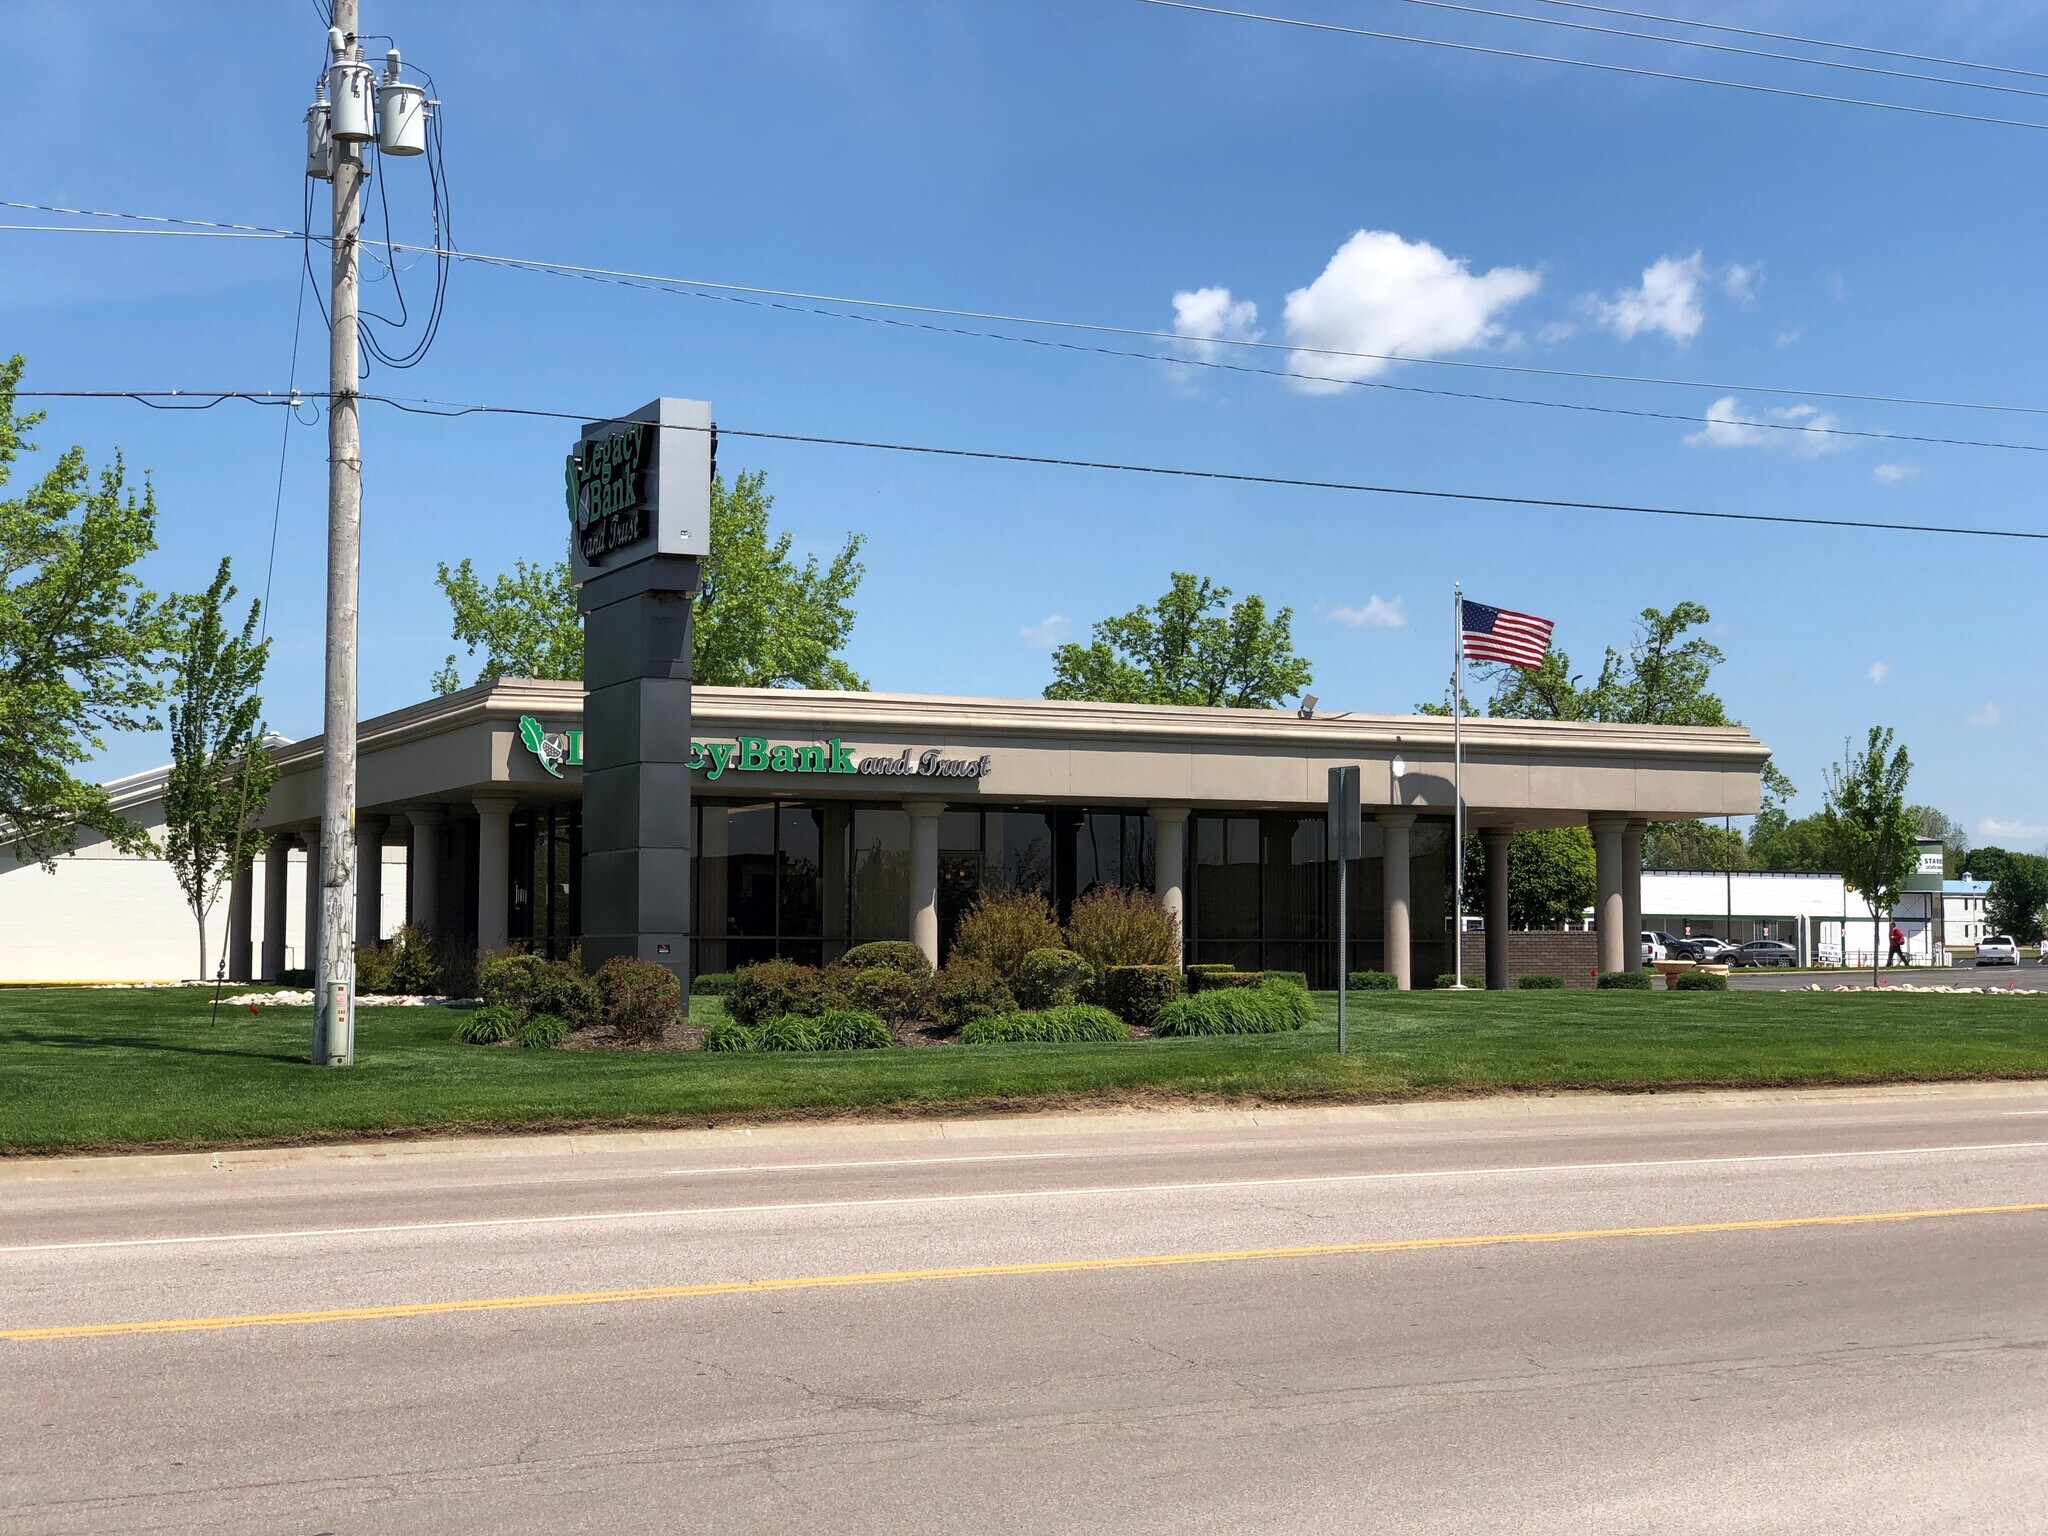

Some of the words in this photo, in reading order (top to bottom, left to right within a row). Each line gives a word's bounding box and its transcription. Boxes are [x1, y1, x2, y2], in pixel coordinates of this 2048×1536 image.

[581, 424, 644, 485] Legacy
[589, 463, 636, 523] Bank
[583, 519, 606, 558] and
[609, 510, 639, 549] Trust
[859, 748, 913, 776] and
[918, 749, 991, 778] Trust
